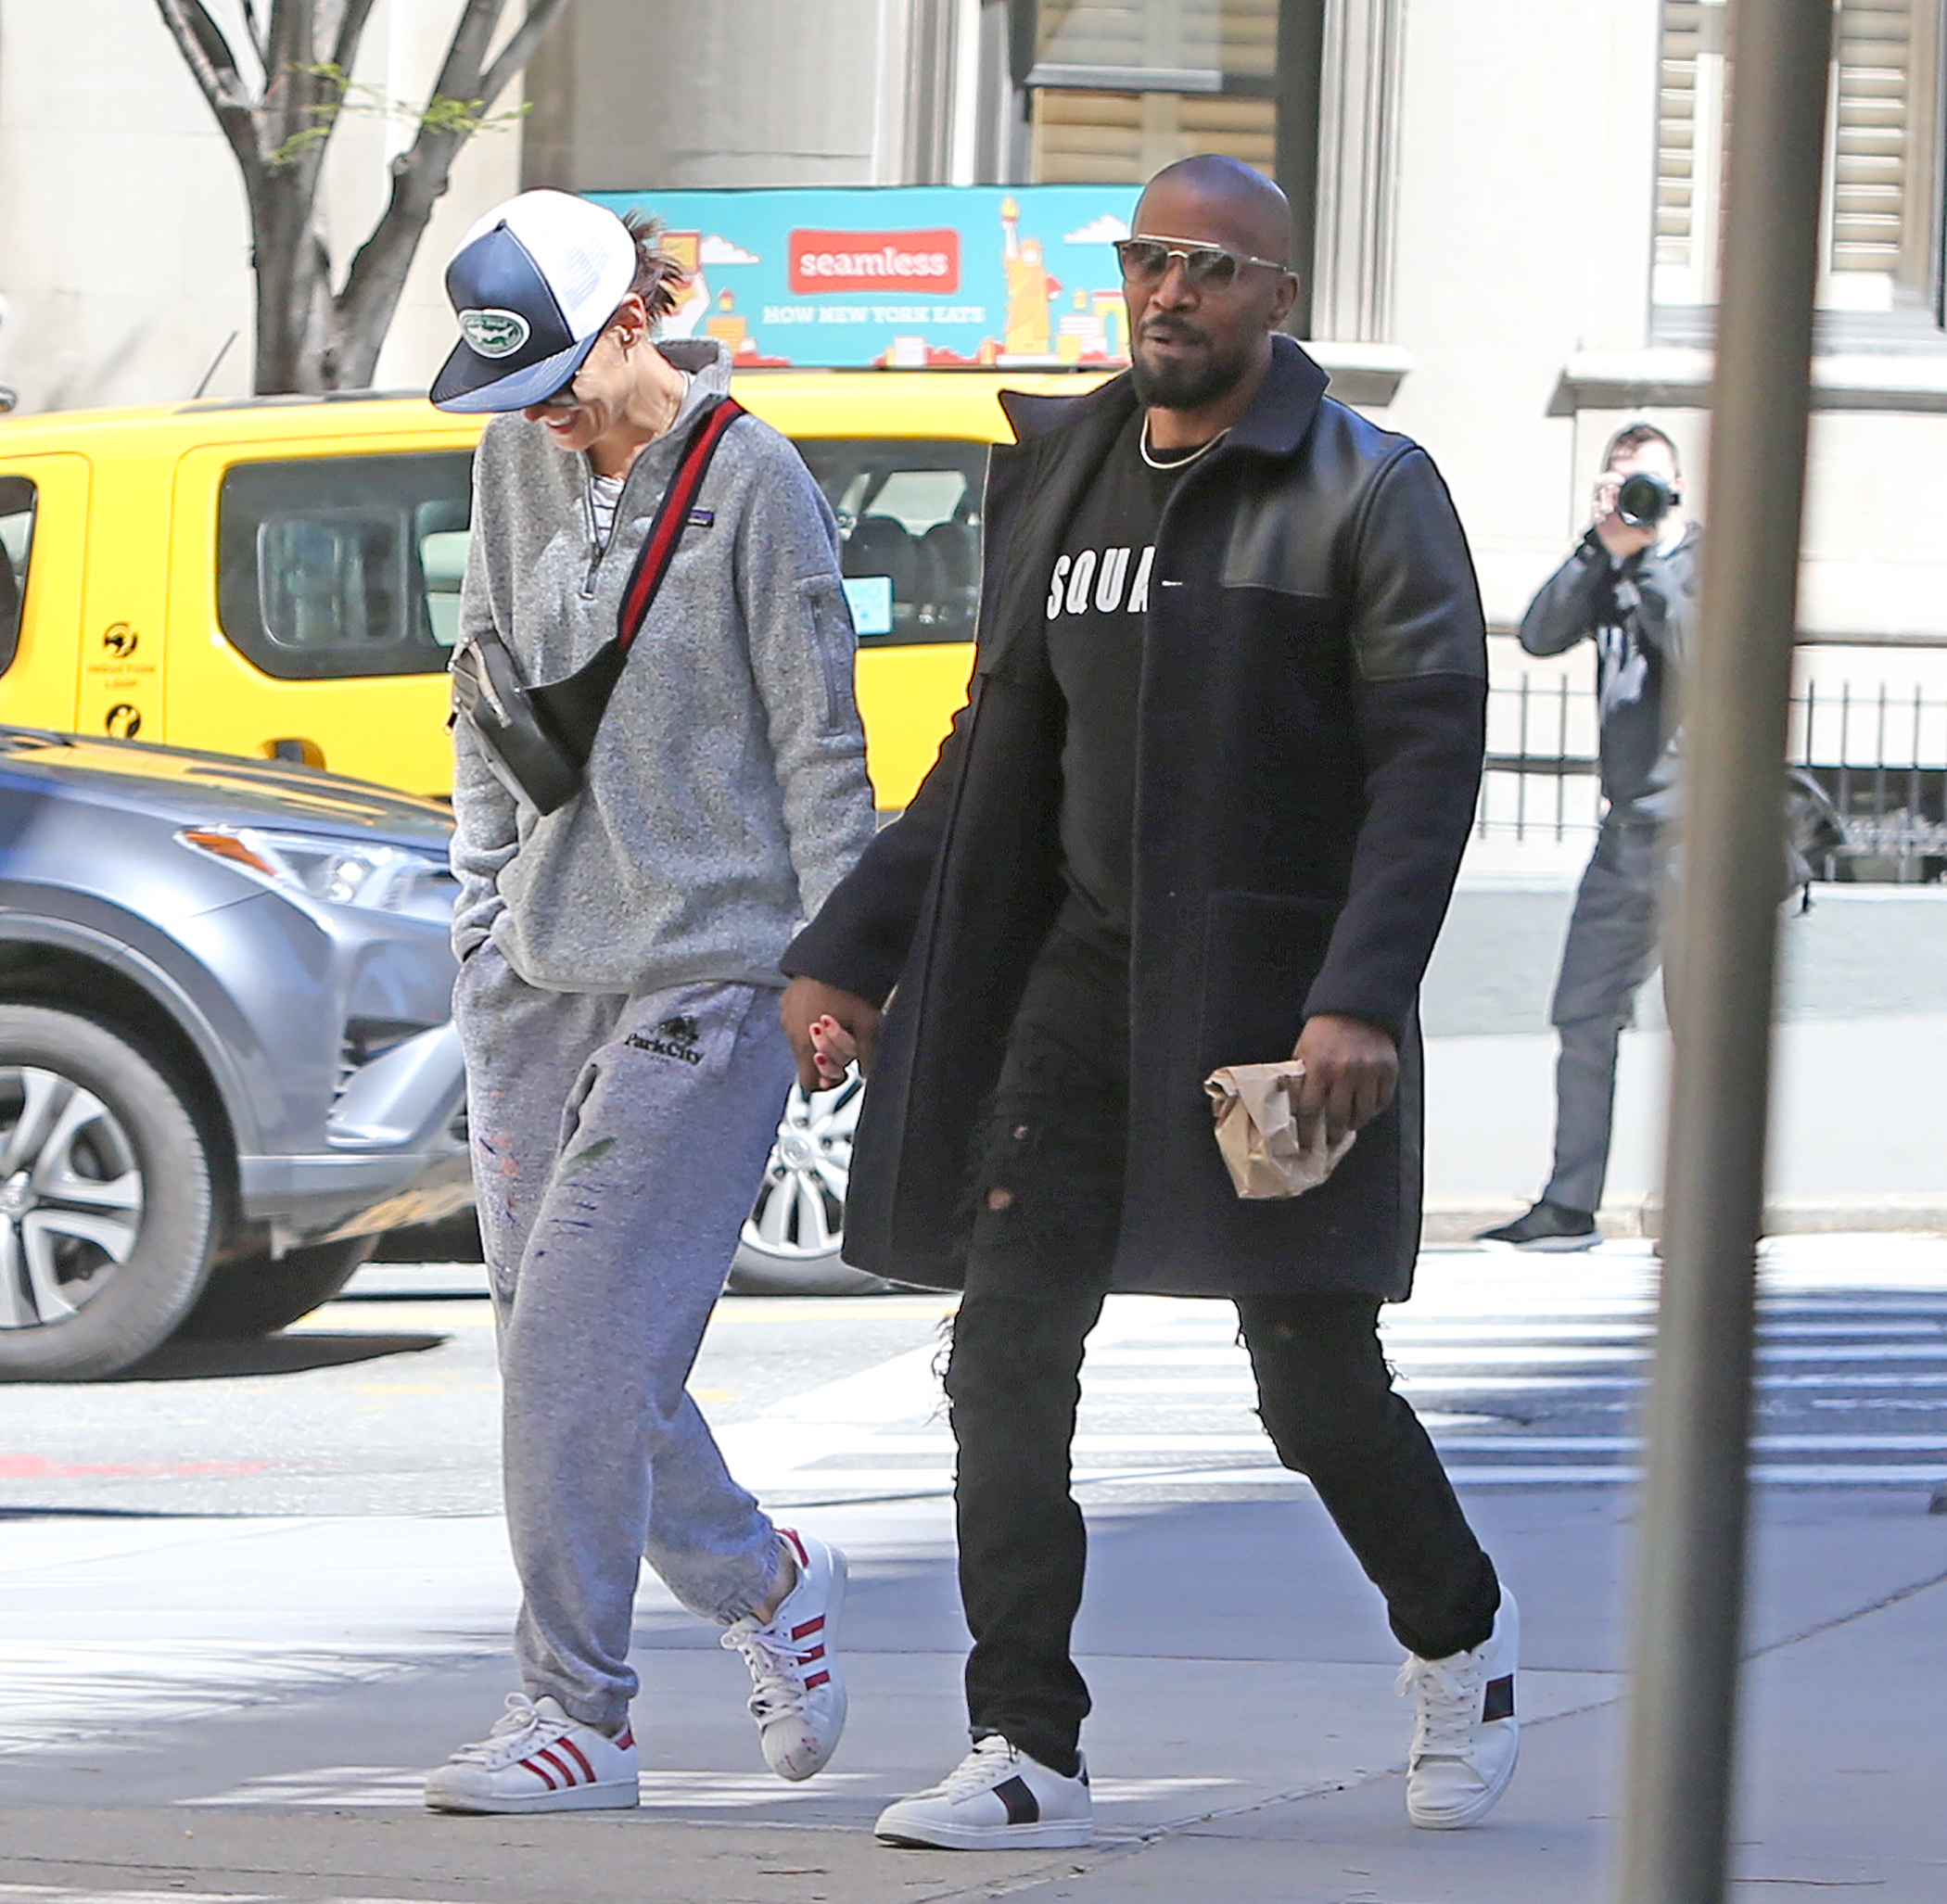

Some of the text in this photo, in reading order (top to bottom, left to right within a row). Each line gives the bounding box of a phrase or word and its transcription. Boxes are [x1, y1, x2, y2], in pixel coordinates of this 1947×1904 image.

[800, 247, 948, 276] seamless
[763, 305, 985, 323] HOW NEW YORK EATS
